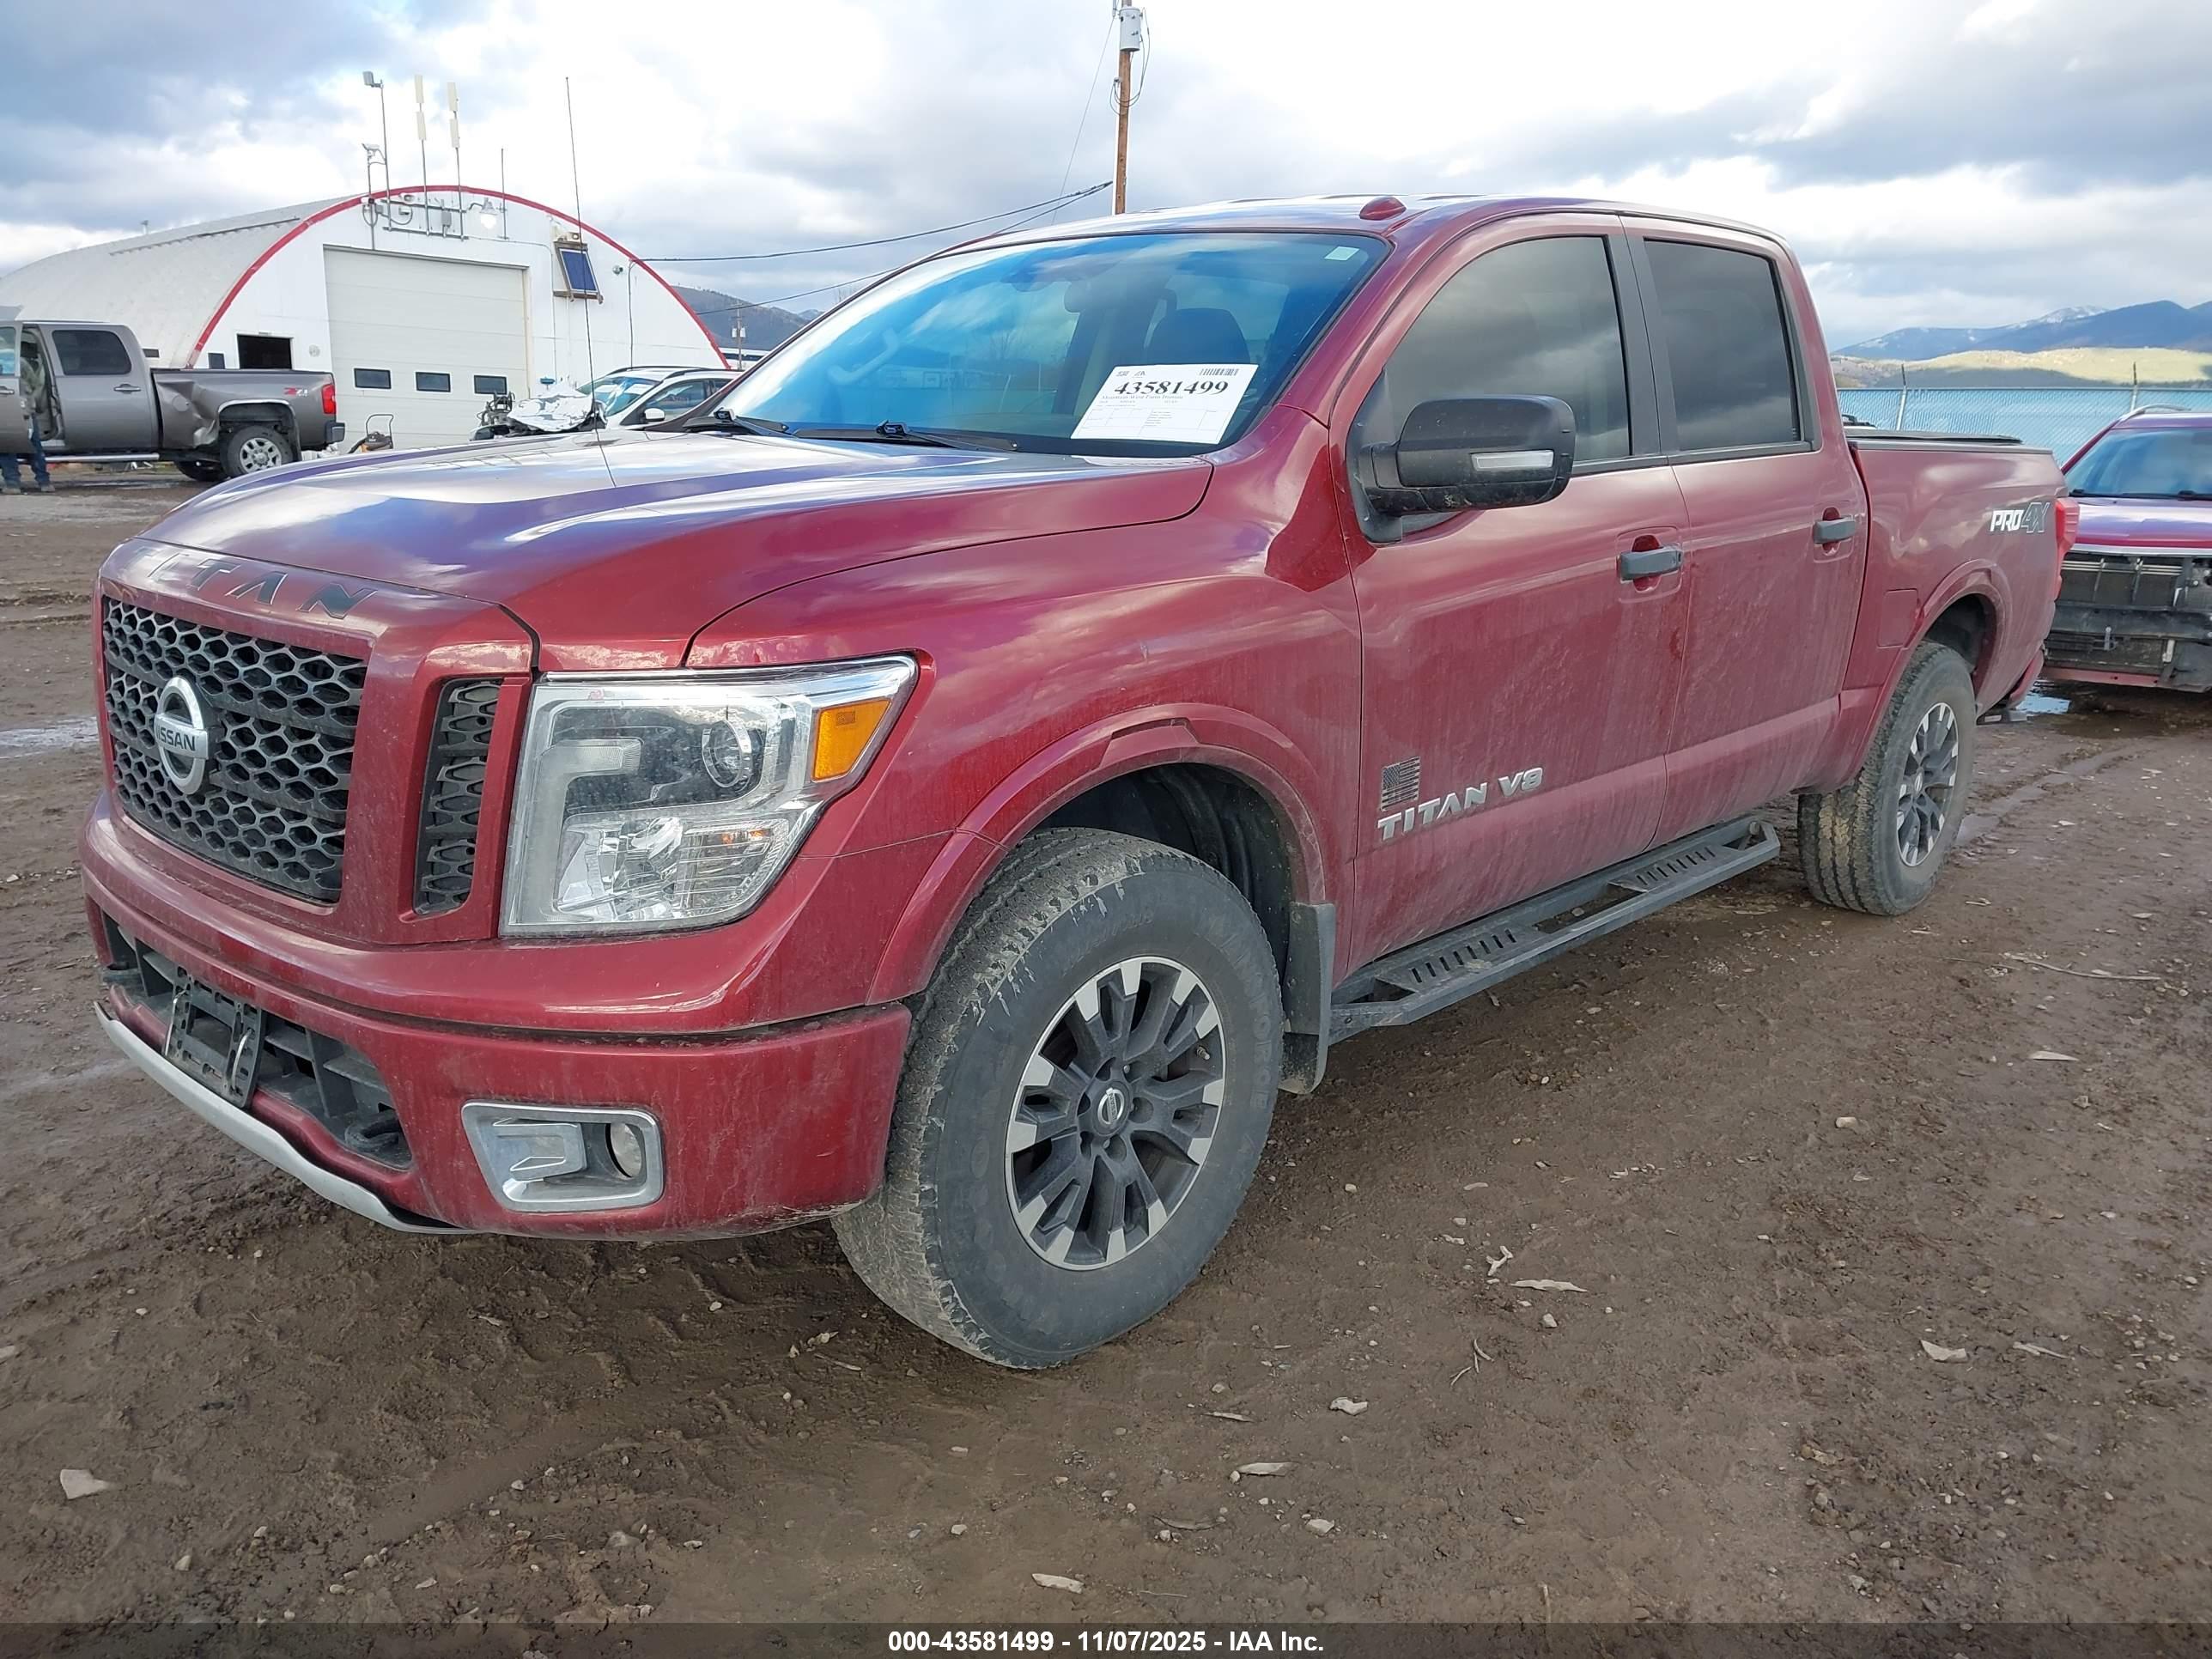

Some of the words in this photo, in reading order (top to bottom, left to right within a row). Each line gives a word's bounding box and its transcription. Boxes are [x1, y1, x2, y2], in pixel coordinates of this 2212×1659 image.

[1115, 380, 1228, 395] 43581499
[127, 546, 378, 619] TITAN
[156, 725, 196, 751] NISSAN
[1377, 782, 1488, 841] TITAN
[1498, 768, 1543, 797] V8
